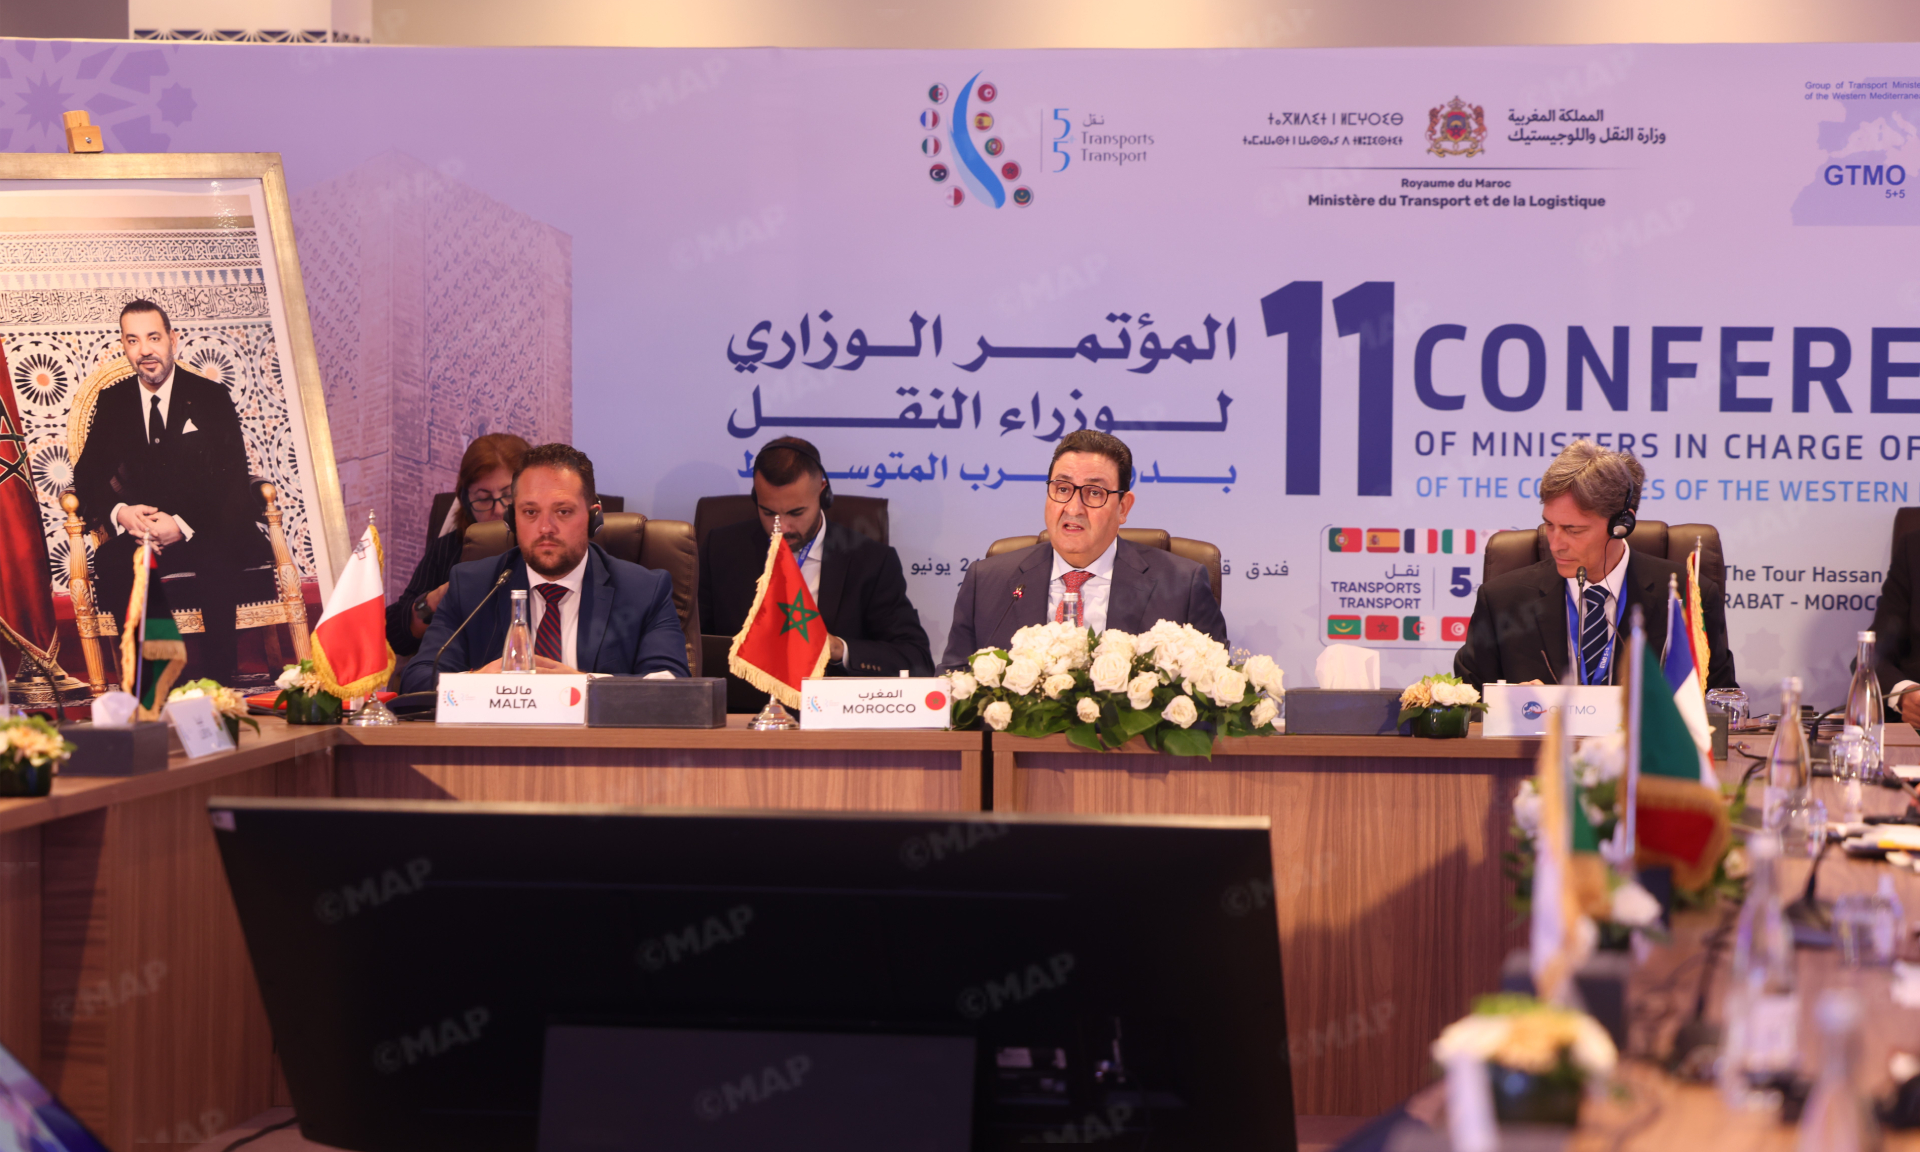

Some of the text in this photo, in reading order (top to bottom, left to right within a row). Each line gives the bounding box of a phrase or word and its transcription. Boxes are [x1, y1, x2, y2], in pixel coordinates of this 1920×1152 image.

[1804, 80, 1832, 91] Group
[1834, 80, 1845, 90] of
[1848, 81, 1888, 91] Transport
[1804, 91, 1814, 101] of
[1815, 92, 1830, 101] the
[1832, 92, 1867, 101] Western
[1082, 113, 1105, 128] نقل
[1508, 108, 1604, 125] المملكة المغربية
[1082, 132, 1154, 148] Transports
[1508, 127, 1666, 145] وزارة النقل واللوجيستيك
[1082, 149, 1146, 166] Transport
[1824, 165, 1905, 185] GTMO
[1400, 177, 1512, 191] Royaume du Maroc
[1308, 193, 1605, 209] Ministère du Transport et de la Logistique
[1885, 188, 1906, 199] 5+5
[727, 310, 1236, 374] المؤتمر الوزاري
[1260, 281, 1920, 496] 11 CONFERE
[726, 384, 981, 438] النقل
[999, 389, 1234, 442] لوزراء
[1415, 431, 1920, 461] OF MINISERS IN CHARGE OF
[959, 463, 1048, 491] رب
[1416, 476, 1448, 497] OF
[1458, 477, 1508, 498] THE
[1676, 479, 1708, 500] OF
[1718, 480, 1769, 501] THE
[1780, 481, 1907, 502] WESTERN
[911, 558, 950, 575] يونيو
[1246, 561, 1288, 580] فندق
[1385, 564, 1419, 579] نقل
[1724, 564, 1882, 583] The Tour Hassan
[1330, 581, 1422, 594] TRANSPORTS
[1338, 596, 1422, 610] TRANSPORT
[1724, 593, 1785, 609] RABAT
[1805, 594, 1883, 611] MOROC
[495, 685, 532, 695] مالطا
[858, 689, 903, 701] المغرب
[489, 698, 537, 709] MALTA
[842, 703, 917, 714] MOROCCO
[1548, 704, 1598, 716] CTMO
